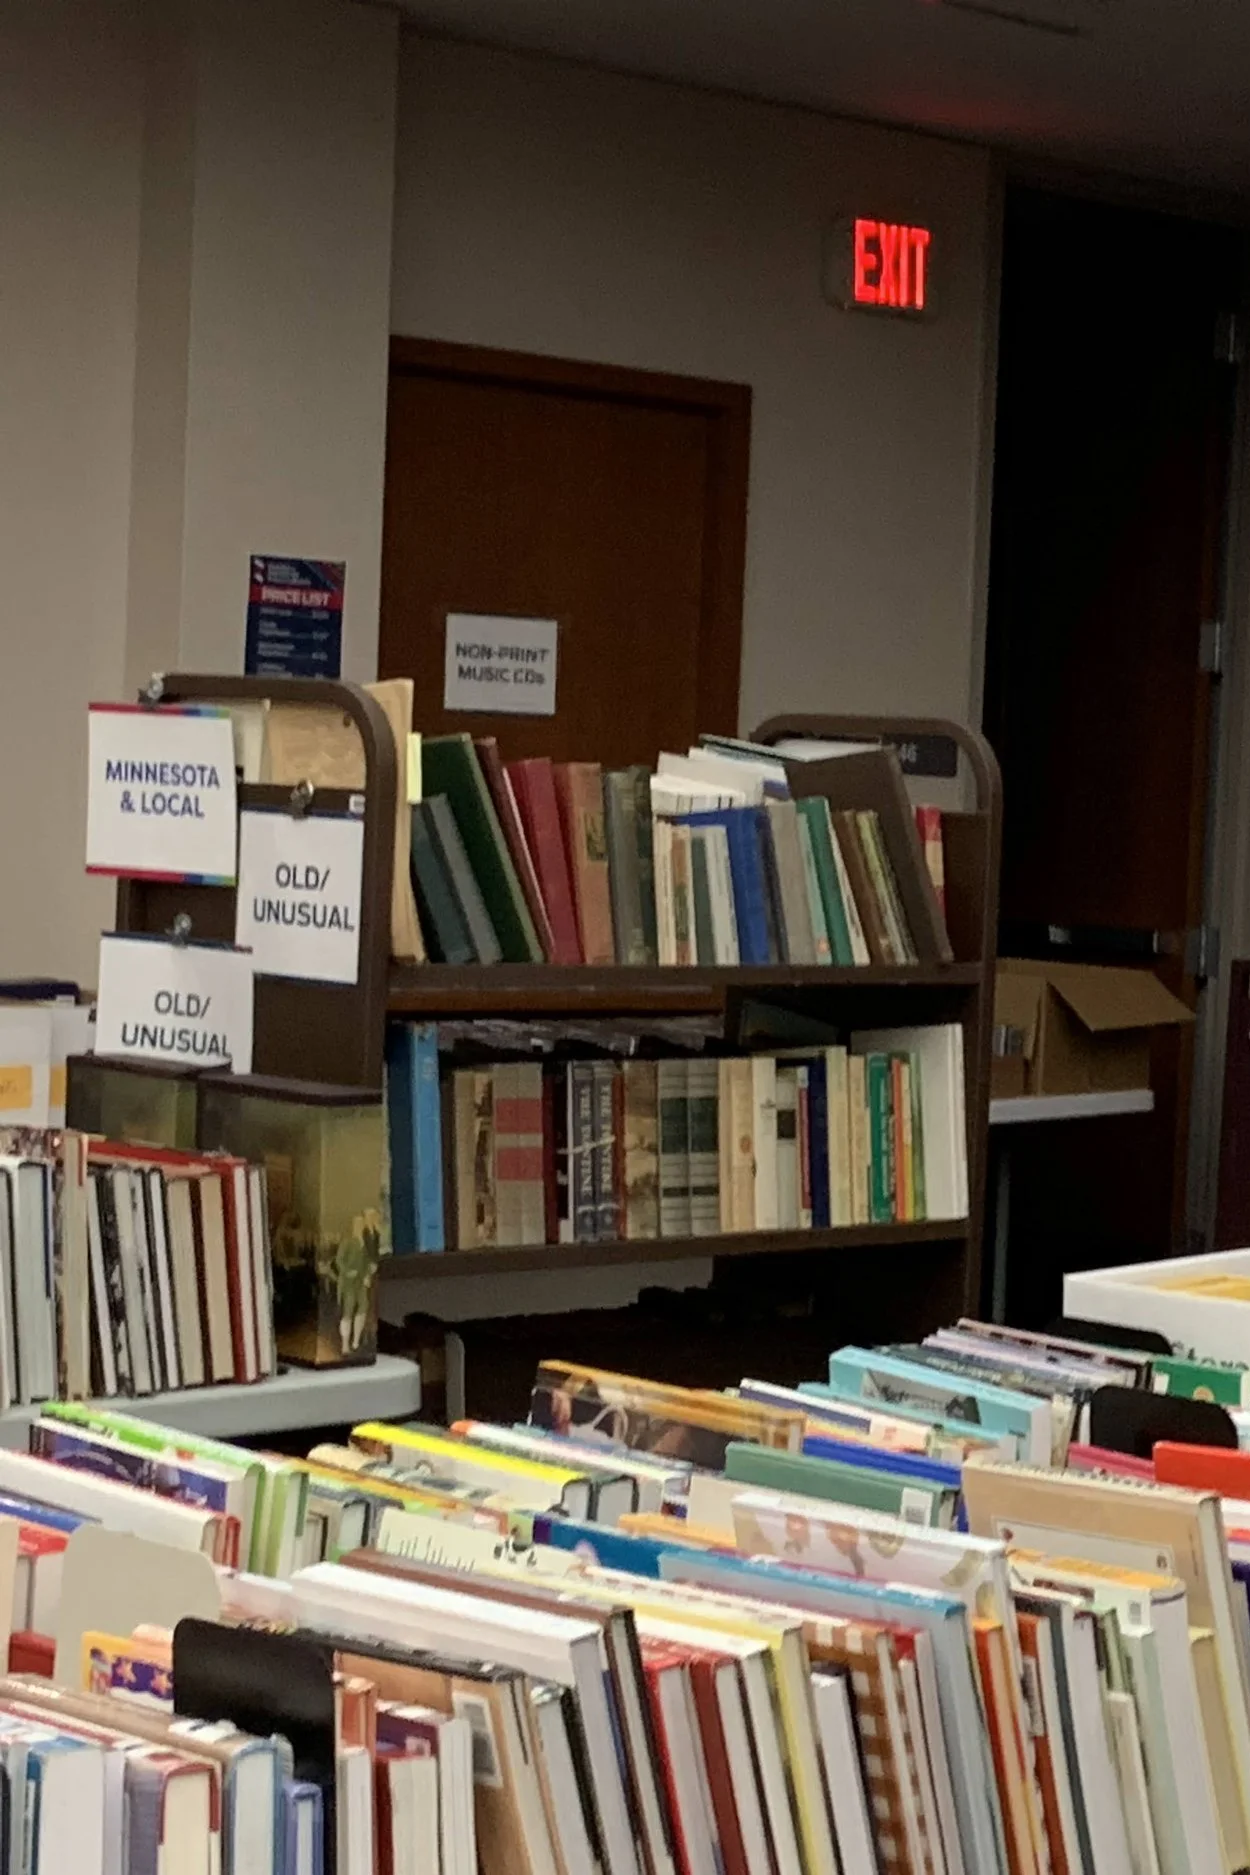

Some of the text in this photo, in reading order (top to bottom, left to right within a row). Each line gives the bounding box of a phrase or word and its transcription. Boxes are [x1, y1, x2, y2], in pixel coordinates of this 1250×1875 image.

[855, 219, 930, 310] EXIT
[458, 664, 511, 683] MUSIC
[105, 759, 221, 789] MINNESOTA
[120, 789, 205, 819] & LOCAL
[275, 863, 330, 891] OLD/
[253, 898, 355, 932] UNUSUAL
[154, 991, 211, 1018] OLD/
[121, 1022, 232, 1058] UNUSUAL
